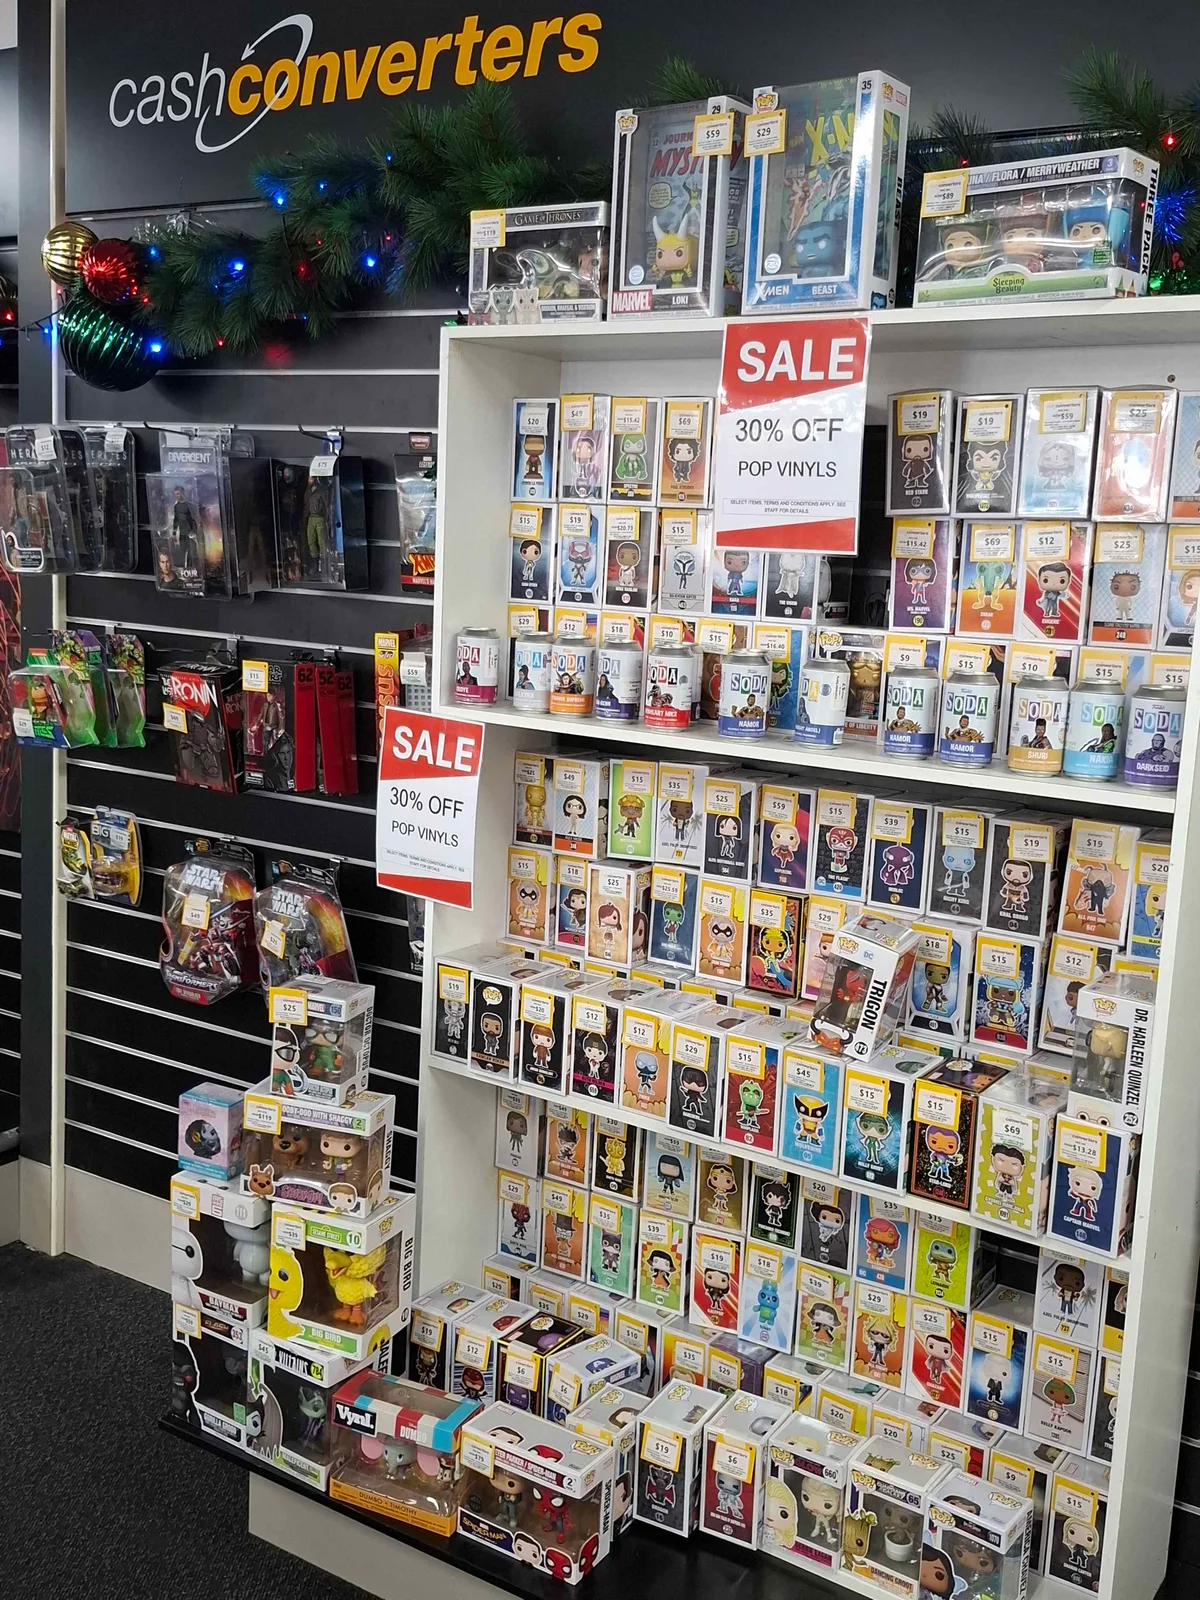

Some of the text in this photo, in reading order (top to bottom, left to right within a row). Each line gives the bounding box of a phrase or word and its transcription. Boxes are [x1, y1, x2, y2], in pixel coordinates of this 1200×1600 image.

[862, 80, 872, 90] 35
[756, 128, 771, 137] $29
[991, 169, 1018, 181] FLORA
[1027, 158, 1099, 177] MERRYWEATHER
[515, 214, 540, 225] GAME
[545, 211, 581, 224] THRONES
[1140, 168, 1159, 276] THREE PACK
[993, 277, 1024, 287] Sleeping
[812, 284, 837, 294] BEAST
[996, 284, 1022, 294] Beauty
[613, 292, 651, 312] MARVEL
[672, 296, 688, 305] LOKI
[737, 337, 857, 382] SALE
[1060, 412, 1073, 420] $59
[1129, 408, 1147, 418] $25
[735, 418, 844, 442] 30% OFF
[168, 452, 212, 463] DIVERGENT
[738, 461, 837, 477] POP VINYLS
[912, 497, 921, 506] 02
[906, 540, 926, 548] $15.42
[985, 537, 1000, 546] $69
[1038, 536, 1054, 545] $12
[180, 569, 198, 577] FOUR
[914, 617, 923, 625] 190
[564, 623, 575, 631] $12
[1116, 631, 1126, 639] 248
[378, 637, 396, 647] MARVEL
[819, 635, 842, 648] POP!
[552, 651, 586, 671] SODA
[959, 660, 974, 669] $15
[297, 668, 314, 683] 62
[408, 668, 418, 676] $59
[1096, 667, 1113, 677] $15
[319, 671, 334, 685] 52
[338, 675, 352, 690] 62
[1165, 674, 1183, 683] $15
[731, 673, 767, 694] SODA
[171, 675, 218, 708] RONIN
[947, 691, 988, 715] SODA
[1019, 698, 1062, 722] SODA
[1081, 701, 1124, 726] SODA
[739, 720, 759, 728] NAMOR
[856, 723, 877, 731] LIBERTY
[1134, 708, 1181, 736] SODA
[890, 734, 911, 743] NAMOR
[393, 726, 475, 773] SALE
[950, 743, 974, 753] NAMOR
[1028, 751, 1048, 760] SHURI
[1089, 755, 1113, 764] NAKIA
[1136, 763, 1169, 772] DARKSEID
[390, 787, 464, 818] 30% OFF
[773, 802, 786, 810] $59
[885, 818, 899, 826] $39
[93, 825, 109, 838] BIG
[392, 821, 459, 847] POP VINYLS
[955, 827, 970, 836] $15
[1086, 838, 1102, 847] $19
[188, 864, 220, 879] STAR
[1151, 863, 1168, 872] $20
[185, 874, 220, 890] WARS
[834, 883, 842, 891] 420
[273, 890, 304, 906] STAR
[711, 897, 723, 905] $15
[272, 901, 301, 918] WARS
[818, 914, 831, 922] $29
[1009, 921, 1017, 929] 04
[925, 940, 940, 949] $18
[1065, 956, 1081, 966] $12
[283, 1004, 297, 1012] $25
[861, 979, 887, 1030] TRIGON
[1093, 999, 1116, 1012] POP!
[330, 1005, 341, 1015] 150
[586, 1012, 598, 1020] $12
[685, 1045, 698, 1055] $29
[1125, 1007, 1149, 1106] DR. HARLEEN QUINZEL
[796, 1068, 811, 1078] $45
[859, 1089, 875, 1099] $15
[258, 1113, 272, 1121] $119
[312, 1109, 327, 1121] WITH
[329, 1112, 352, 1124] SHAGGY
[1124, 1114, 1137, 1124] 252
[384, 1130, 392, 1170] SHAGGY
[1073, 1145, 1096, 1157] $13.28
[508, 1185, 519, 1193] $29
[600, 1211, 611, 1220] $35
[648, 1225, 660, 1233] $39
[348, 1233, 360, 1245] 10
[403, 1236, 413, 1292] BIG BIRD
[758, 1259, 771, 1268] $18
[868, 1293, 882, 1303] $29
[209, 1296, 239, 1314] BAYMAX
[923, 1314, 938, 1324] $25
[231, 1330, 242, 1341] 353
[311, 1327, 342, 1344] BIG BIRD
[626, 1330, 638, 1339] $10
[467, 1345, 478, 1354] $12
[684, 1352, 696, 1361] $35
[719, 1366, 730, 1375] $29
[560, 1385, 568, 1393] $6
[776, 1387, 788, 1397] $18
[400, 1426, 427, 1443] DUMBO
[884, 1428, 898, 1438] $20
[728, 1455, 738, 1464] $6
[941, 1450, 955, 1460] $25
[506, 1453, 524, 1467] PARKER
[528, 1463, 556, 1482] SPIDER-MAN
[824, 1469, 836, 1479] 660
[908, 1494, 919, 1505] 65
[1067, 1497, 1082, 1508] $15
[602, 1478, 612, 1535] SPIDER-MAN
[929, 1507, 955, 1527] POP!
[870, 1567, 913, 1589] DANCING GROOT
